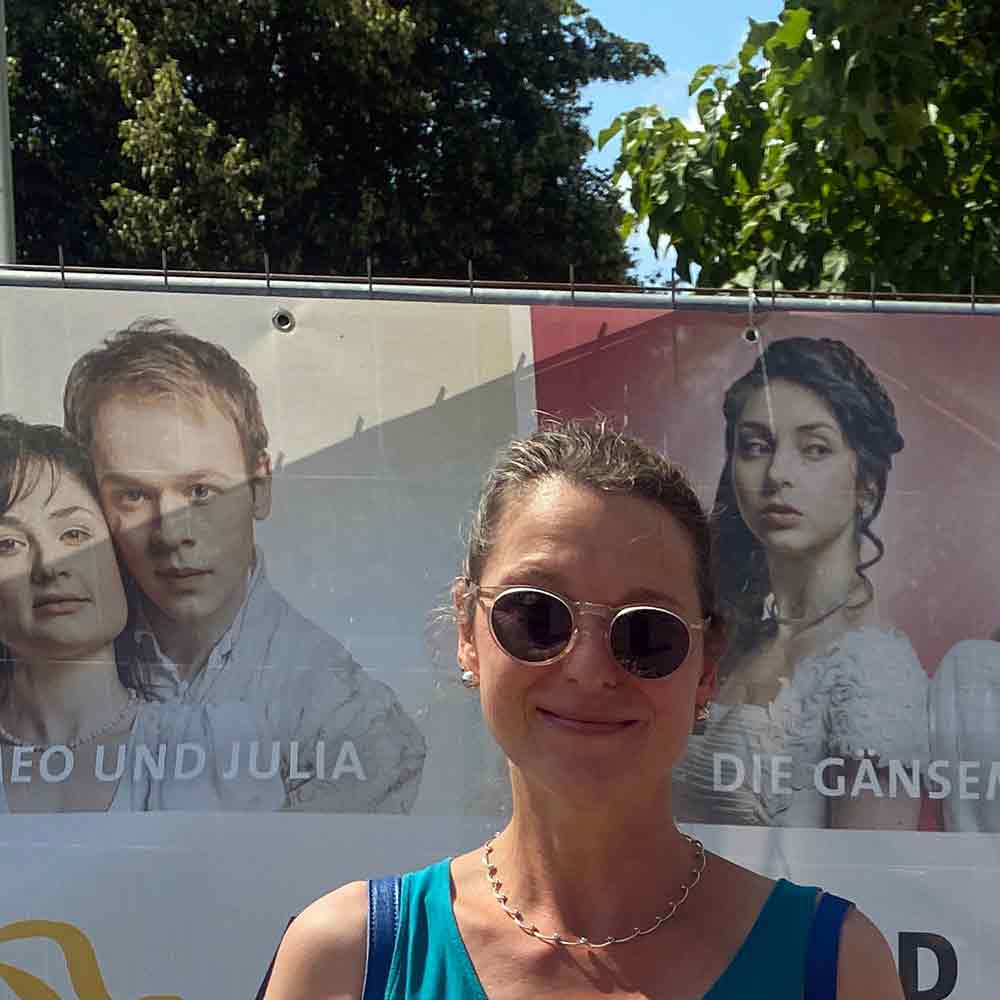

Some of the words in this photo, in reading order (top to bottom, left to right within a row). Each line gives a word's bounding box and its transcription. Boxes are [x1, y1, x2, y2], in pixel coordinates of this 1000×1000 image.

[0, 744, 75, 783] EO
[95, 743, 206, 782] UND
[222, 741, 368, 781] JULIA
[711, 751, 793, 794] DIE
